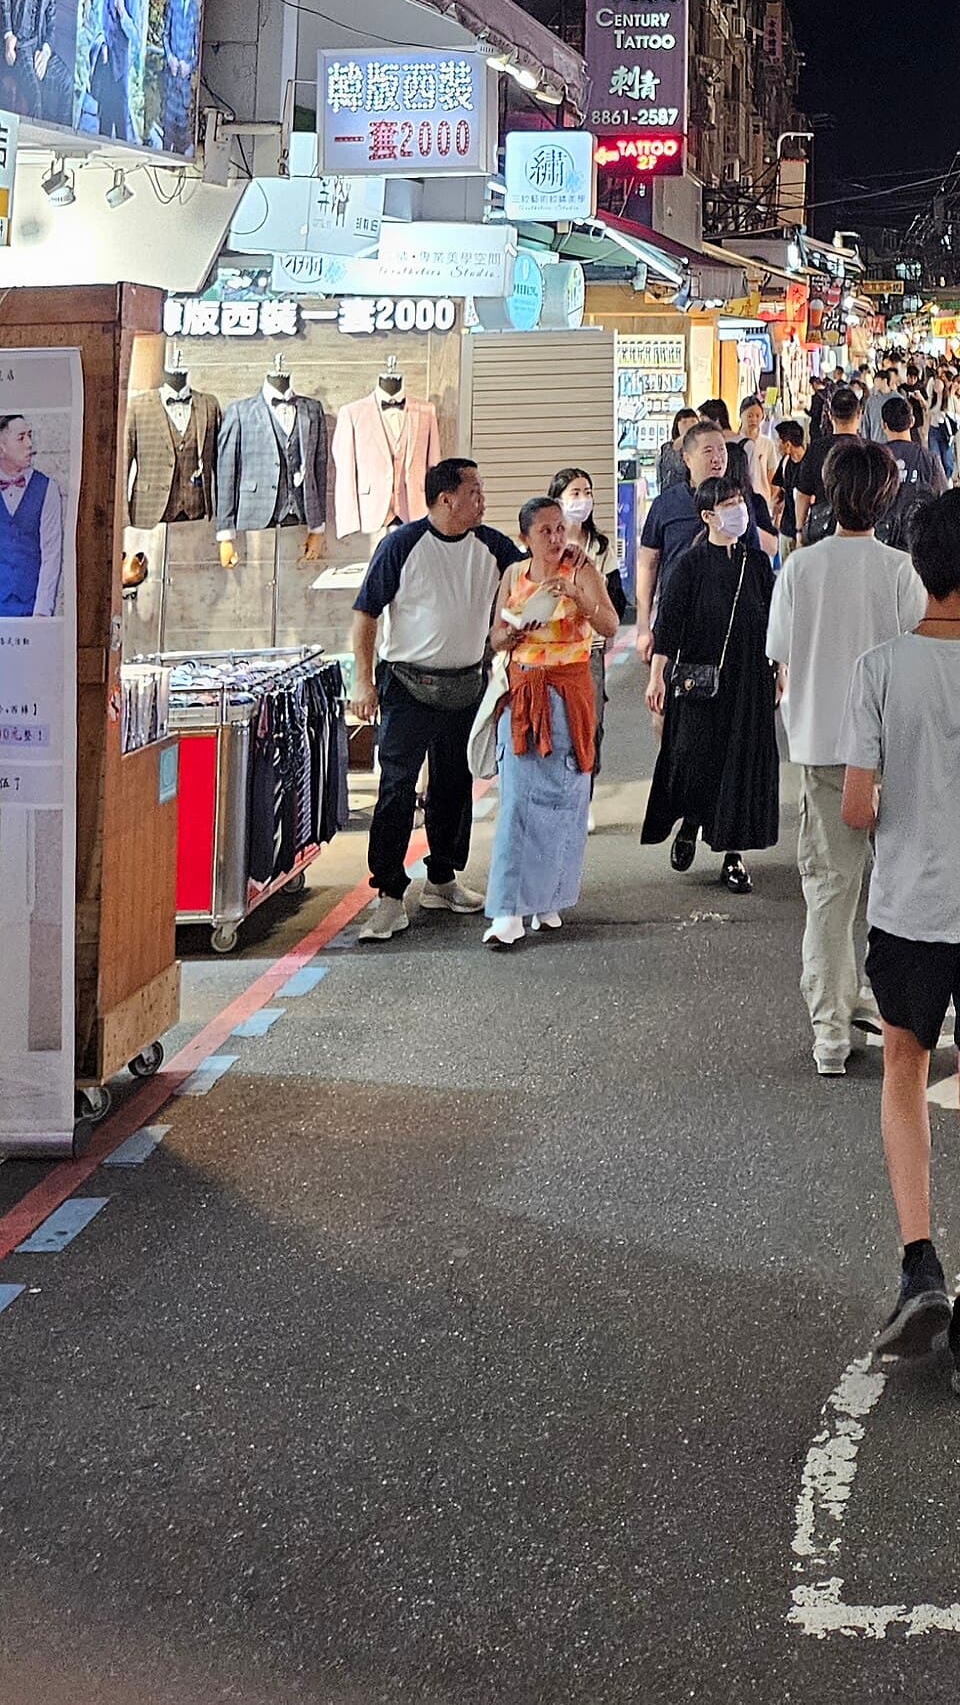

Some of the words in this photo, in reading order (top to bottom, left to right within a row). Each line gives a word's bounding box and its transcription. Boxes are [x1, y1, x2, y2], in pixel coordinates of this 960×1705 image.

[595, 7, 671, 28] CENTURY
[614, 30, 676, 50] TATTOO
[327, 60, 474, 113] 韓版西裝
[609, 65, 661, 101] 刺青
[591, 108, 679, 126] 8861-2587
[334, 118, 471, 161] 一套2000
[616, 139, 678, 157] TATTOO
[636, 154, 657, 171] 2F
